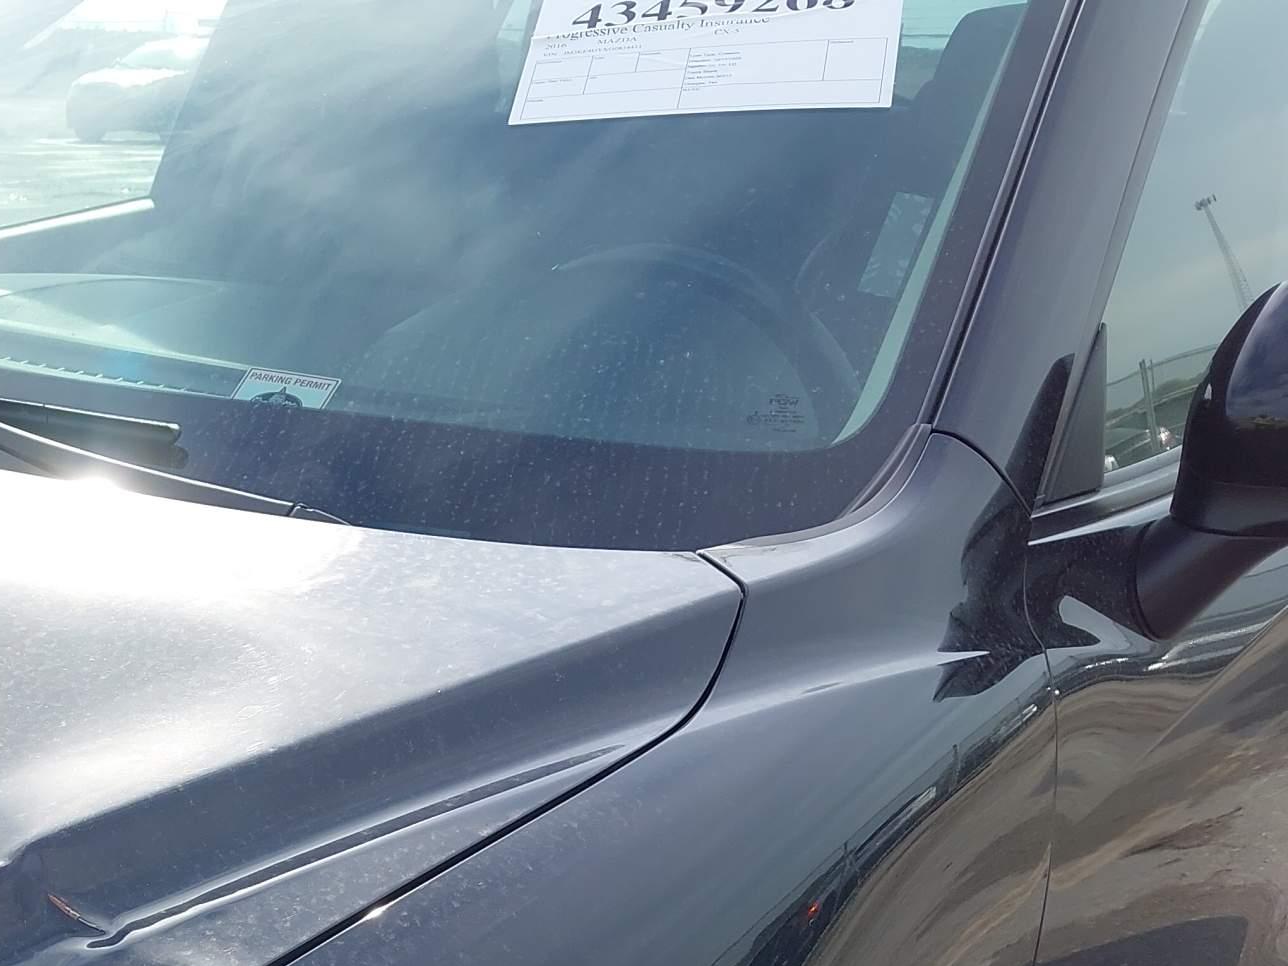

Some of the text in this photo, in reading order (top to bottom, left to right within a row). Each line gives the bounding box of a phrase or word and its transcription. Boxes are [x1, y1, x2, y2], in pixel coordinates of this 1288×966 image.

[632, 20, 695, 34] Casualty
[250, 371, 332, 391] PARKING PERMIT
